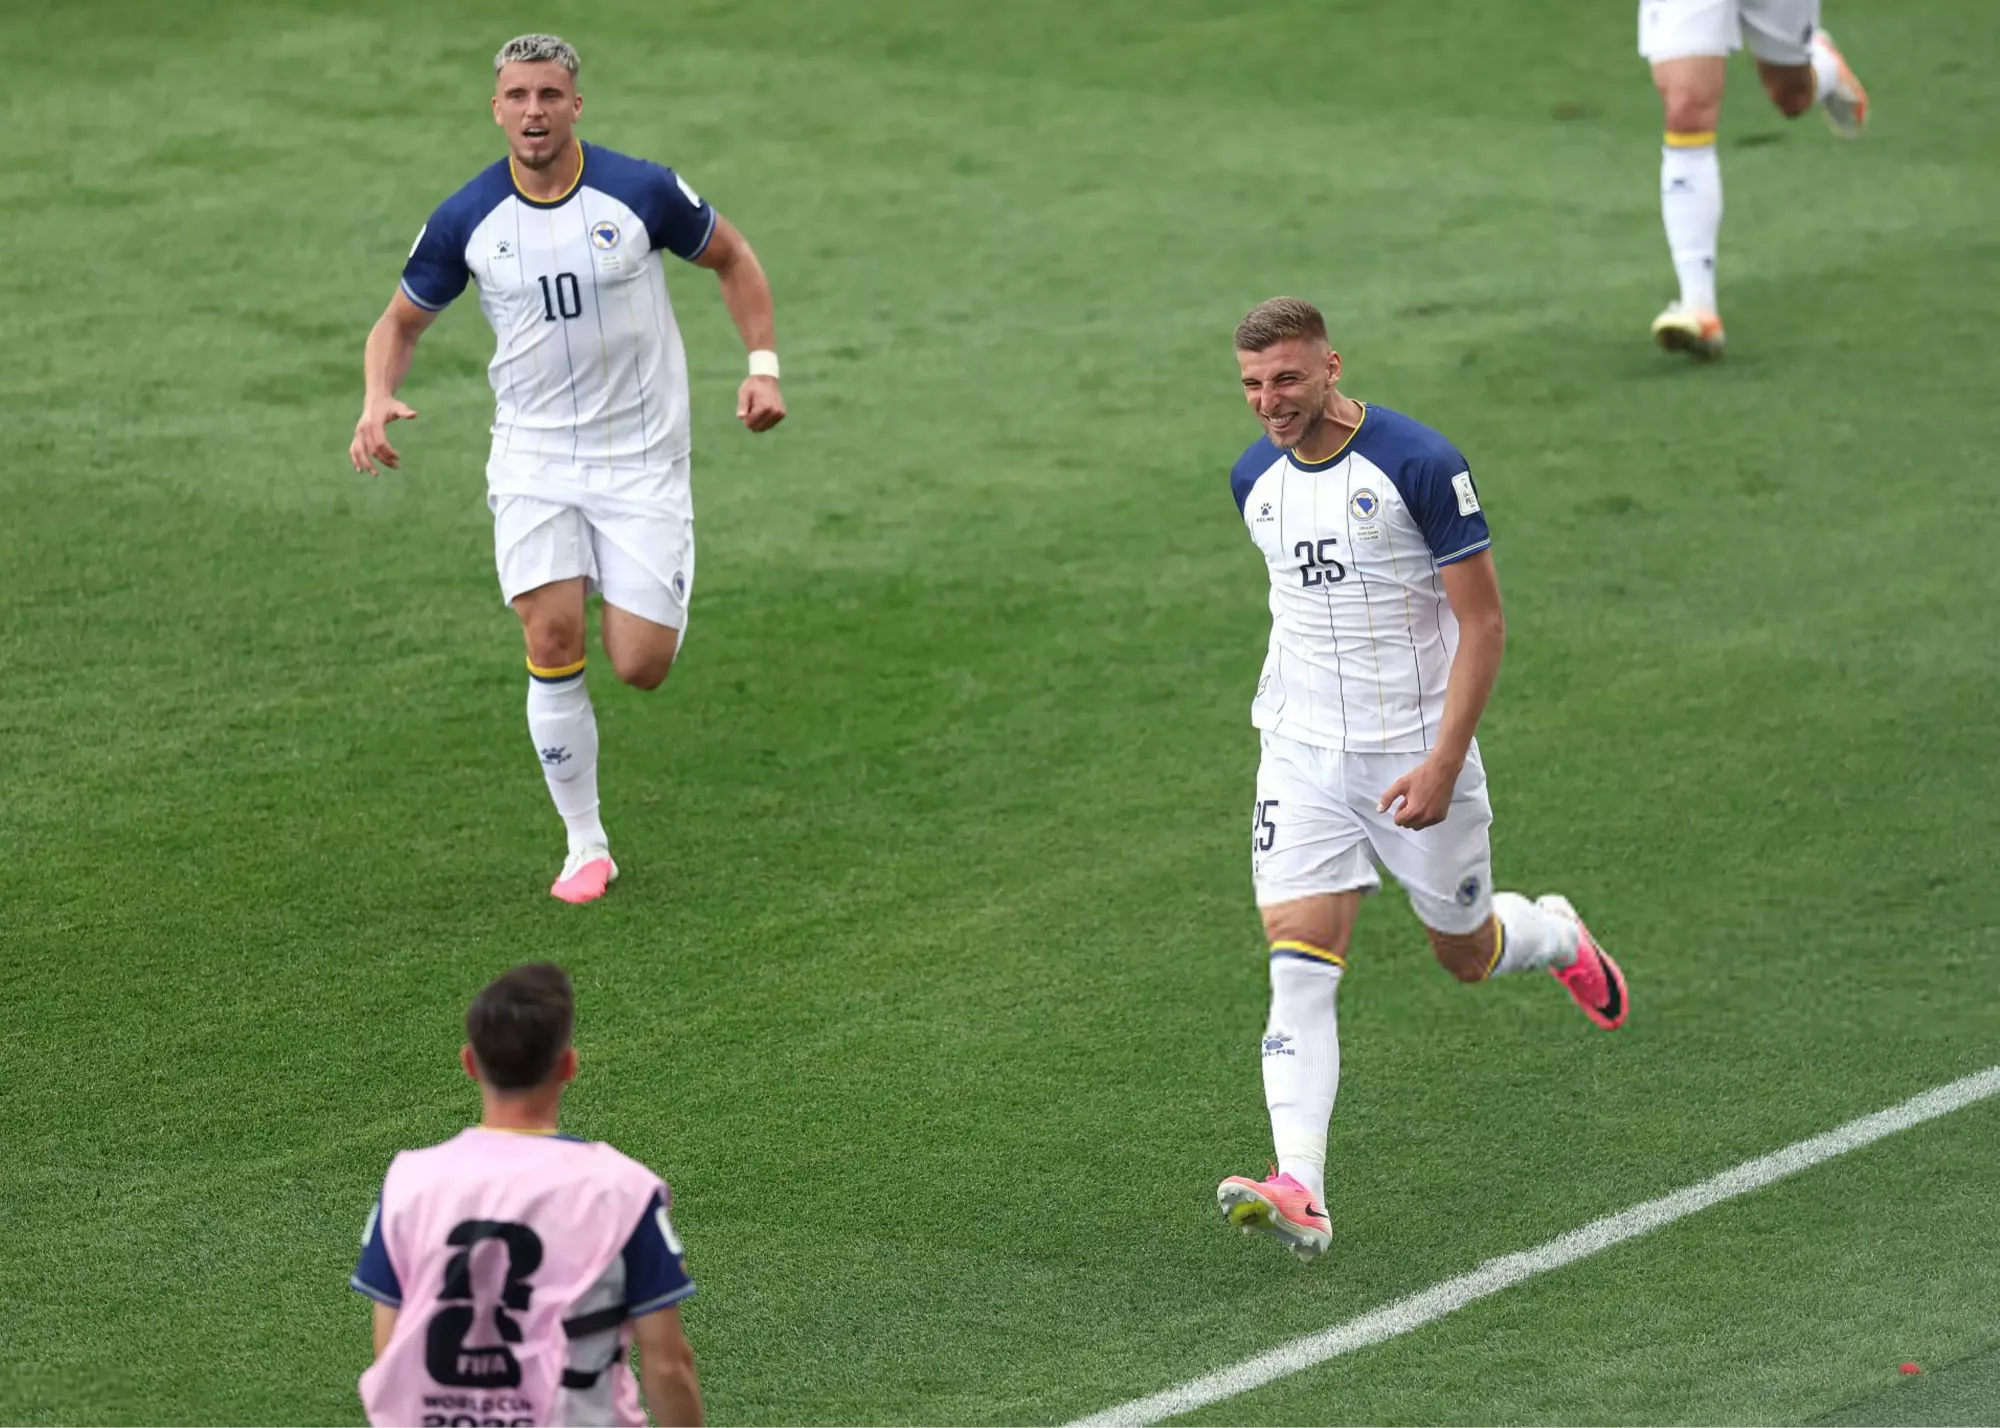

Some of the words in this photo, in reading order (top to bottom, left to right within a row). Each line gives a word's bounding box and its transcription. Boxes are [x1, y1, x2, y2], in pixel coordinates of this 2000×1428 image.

[538, 272, 582, 322] 10
[1294, 538, 1346, 588] 25
[457, 1354, 508, 1376] FIFA
